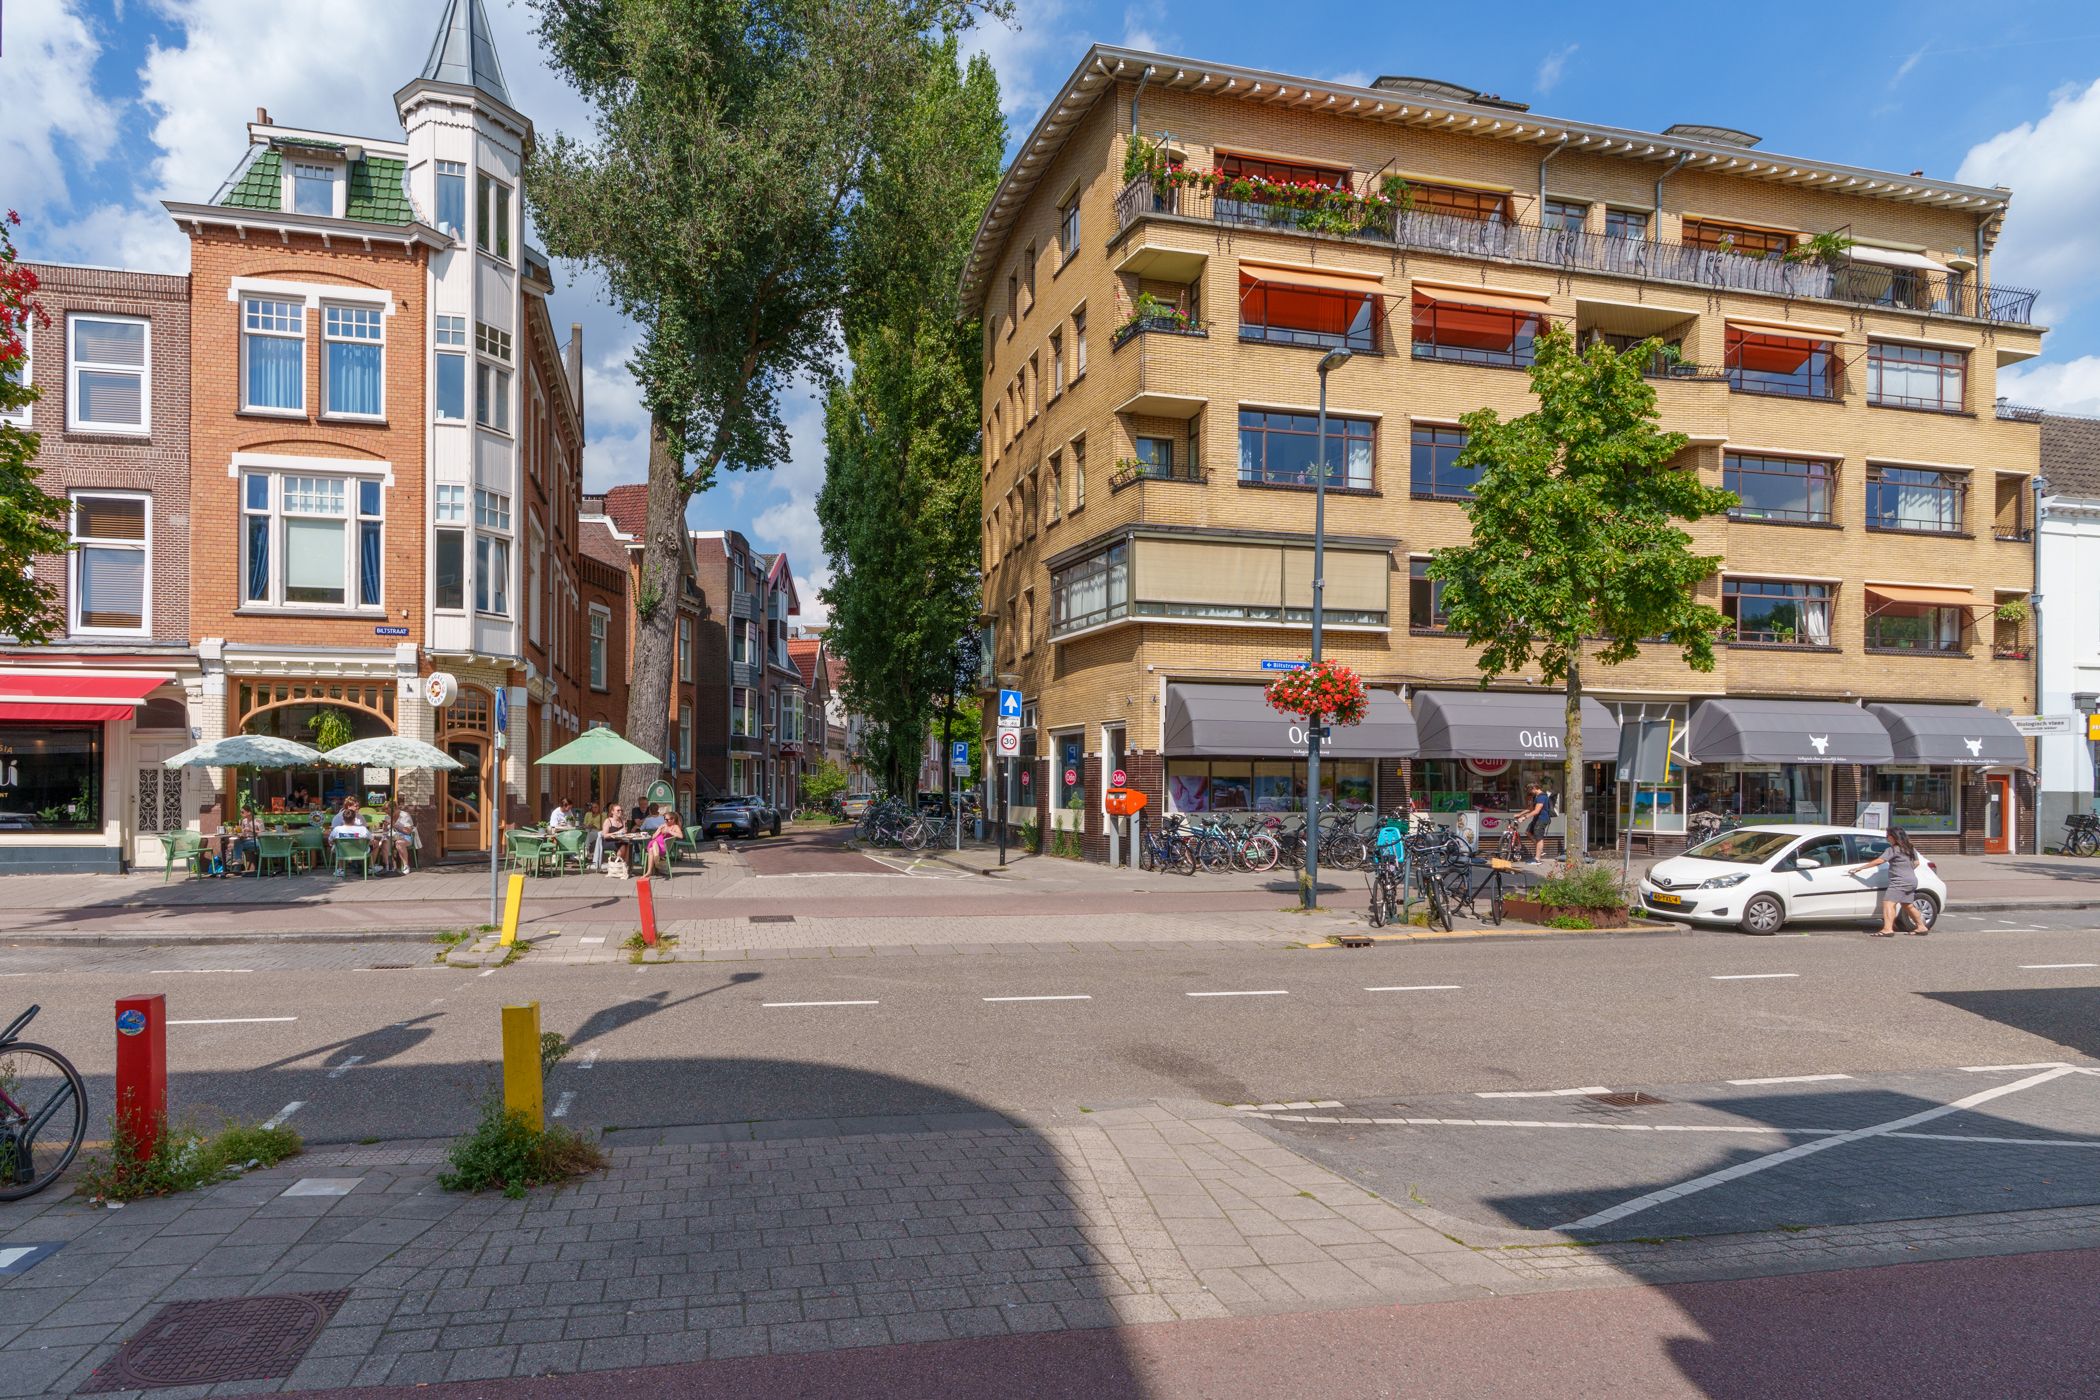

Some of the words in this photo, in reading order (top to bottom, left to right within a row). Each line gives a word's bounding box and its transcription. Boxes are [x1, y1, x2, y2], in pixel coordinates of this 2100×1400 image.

[376, 627, 407, 635] BILTSTRAAT
[1004, 737, 1014, 745] 30
[1519, 730, 1559, 748] Odin
[956, 744, 965, 756] P
[1065, 773, 1076, 782] Odin
[1113, 773, 1125, 782] Odin
